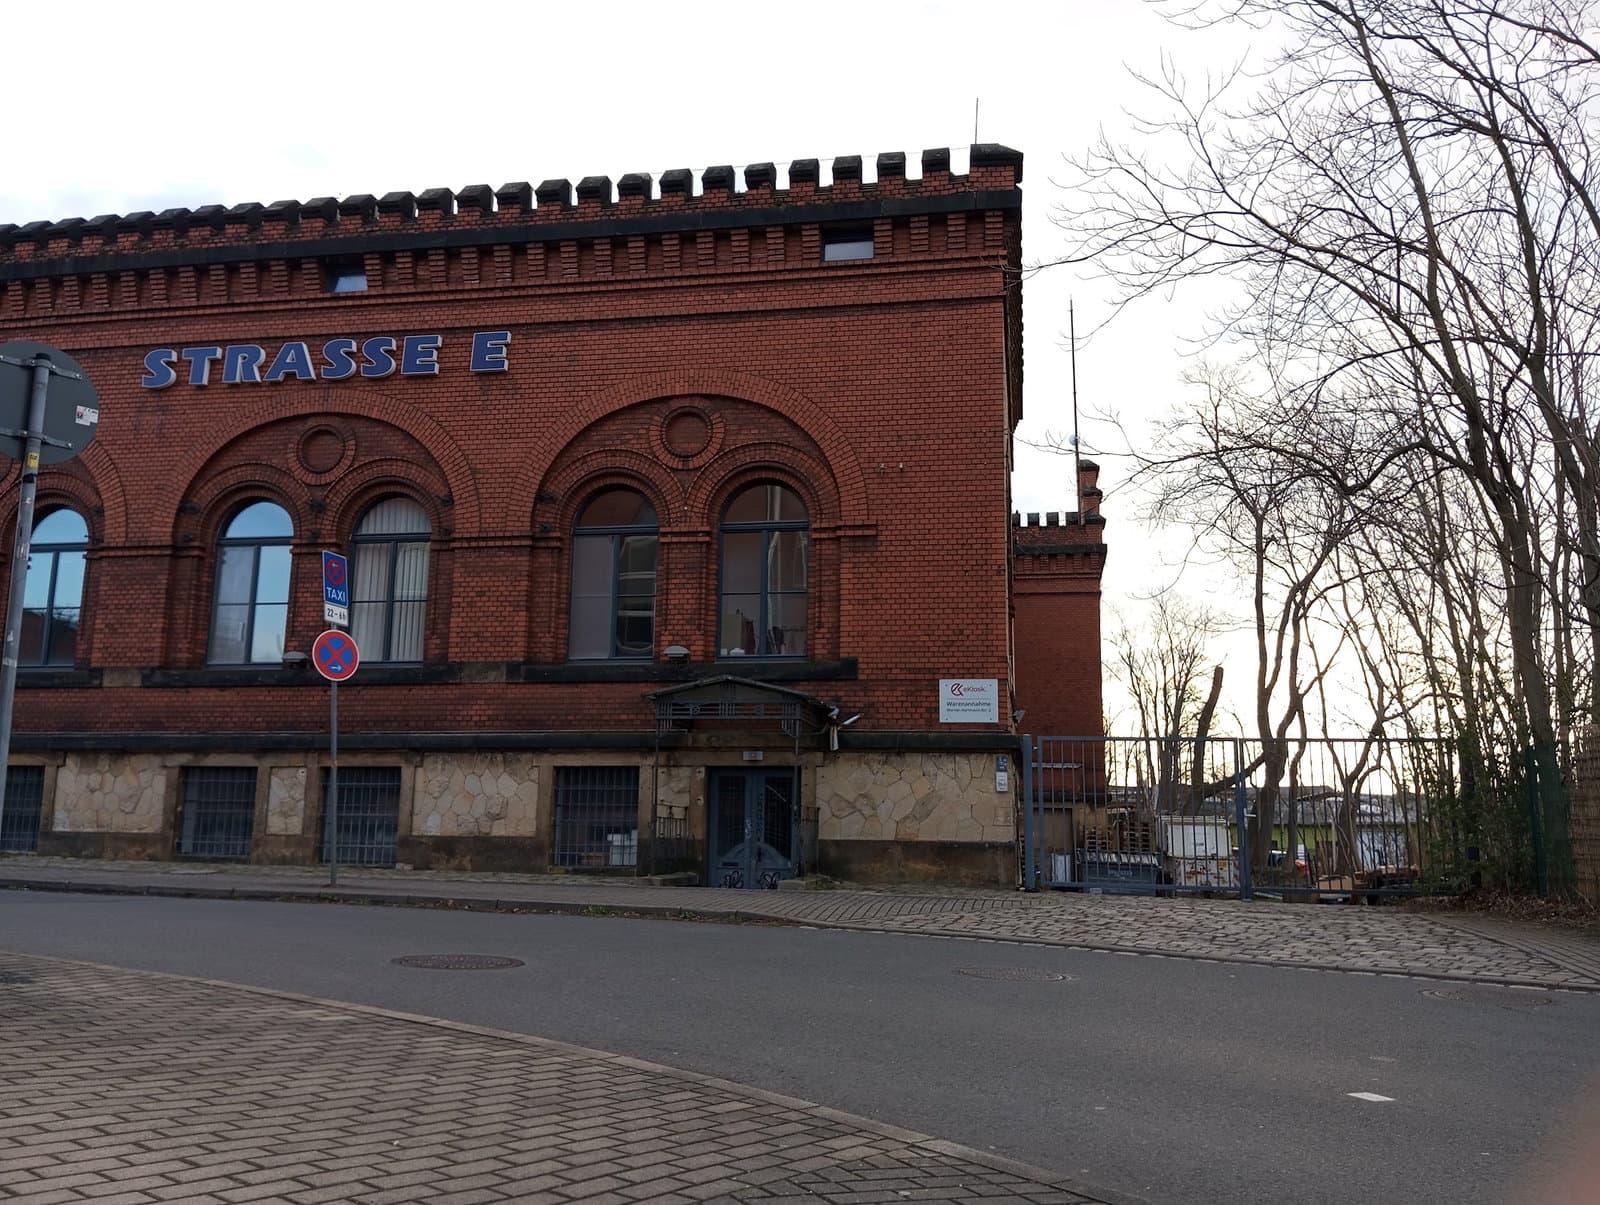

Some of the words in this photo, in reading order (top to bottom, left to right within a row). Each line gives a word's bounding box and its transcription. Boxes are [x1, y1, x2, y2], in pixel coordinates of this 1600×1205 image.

[141, 334, 442, 388] STRASSE
[470, 331, 511, 372] E
[326, 587, 346, 602] TAXI
